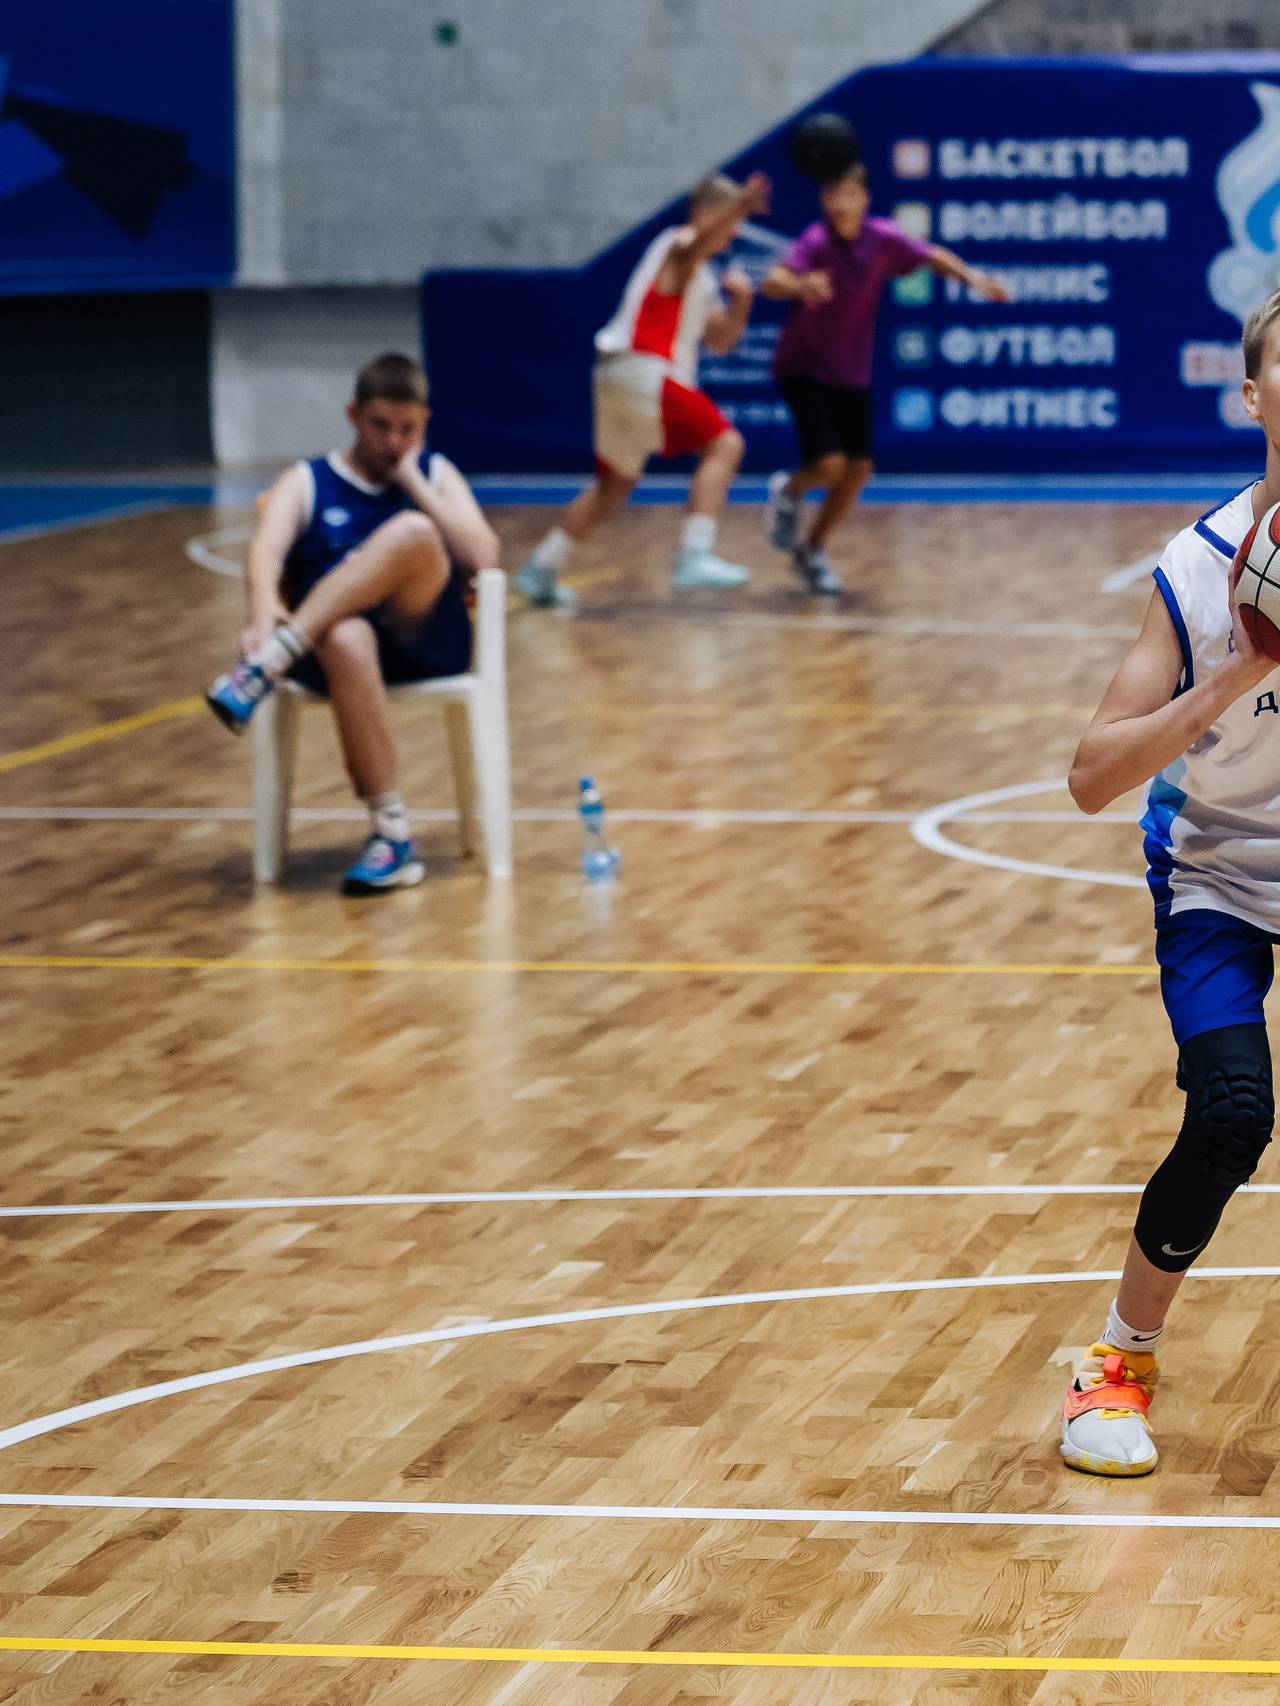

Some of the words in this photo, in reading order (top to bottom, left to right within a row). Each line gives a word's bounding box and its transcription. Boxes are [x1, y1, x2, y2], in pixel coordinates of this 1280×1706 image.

[940, 138, 1188, 178] БАСКЕТБОЛ
[940, 194, 1167, 240] ВОЛЕЙБОЛ
[940, 326, 1116, 365] ФУТБОЛ
[940, 388, 1118, 427] ФИТНЕС
